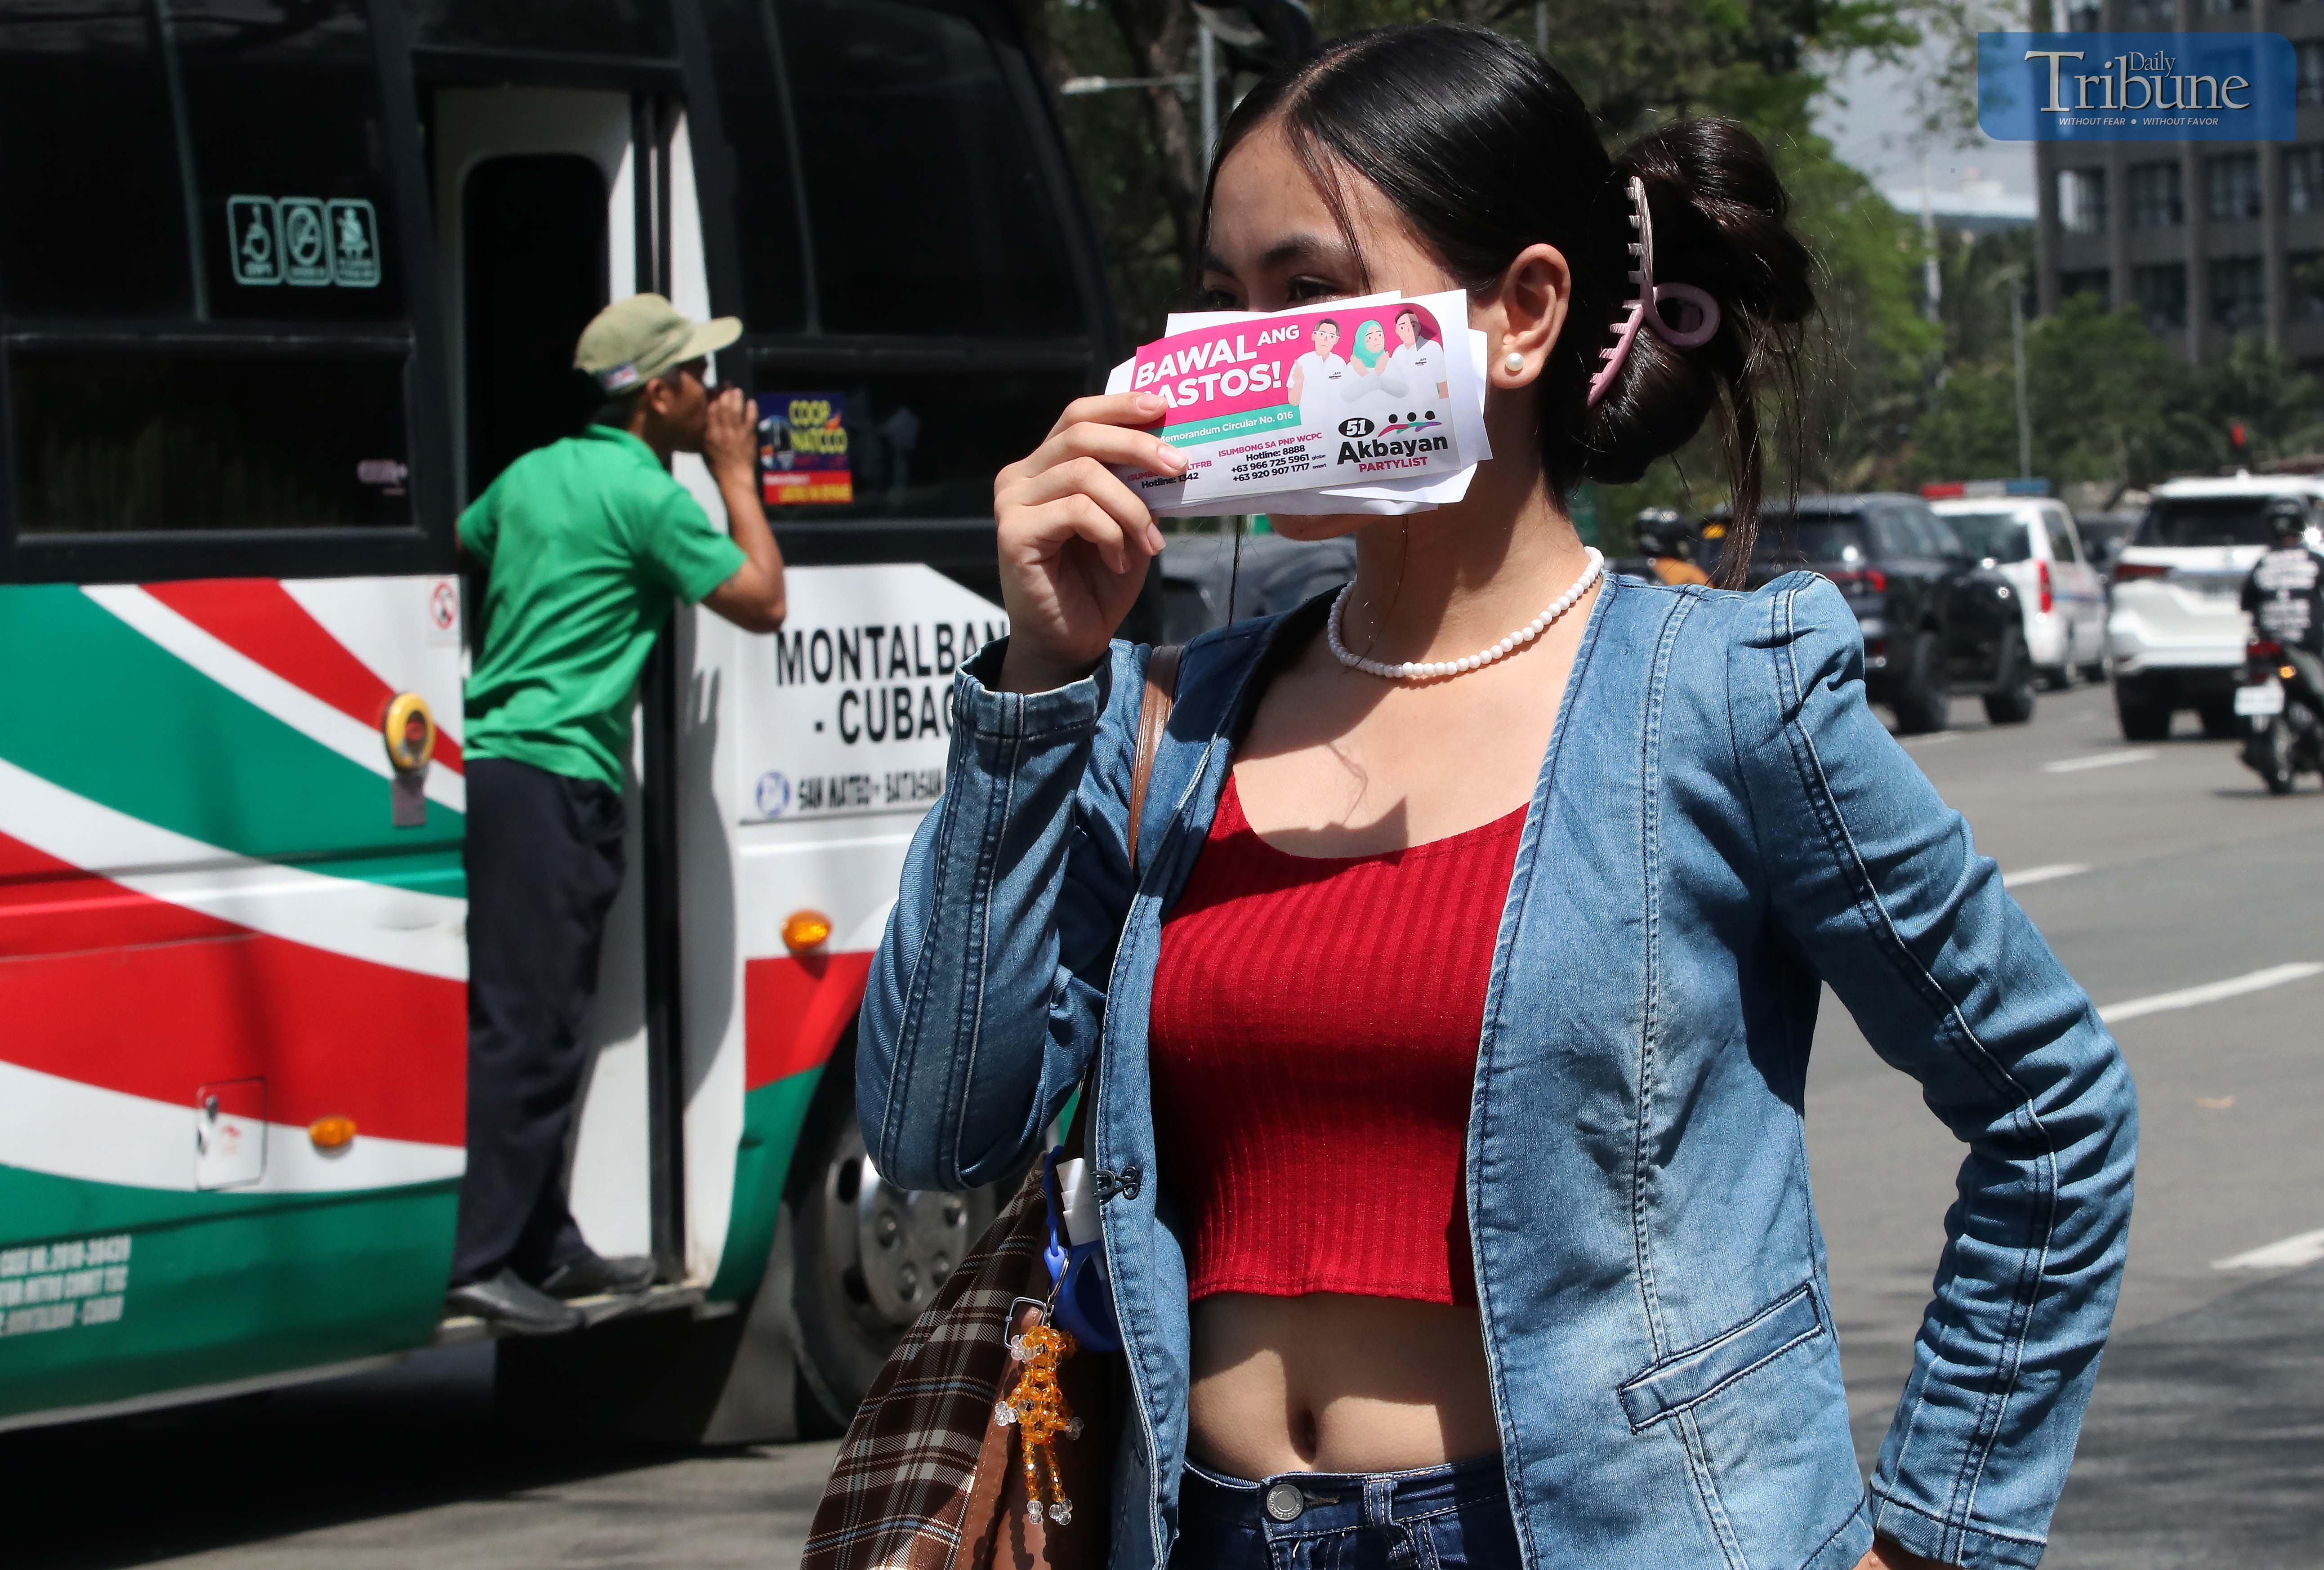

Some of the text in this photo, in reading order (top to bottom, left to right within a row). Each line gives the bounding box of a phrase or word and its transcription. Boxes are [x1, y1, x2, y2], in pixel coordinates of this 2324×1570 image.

[1134, 325, 1300, 390] BAWAL ANG
[1143, 361, 1281, 409] ASTOS!
[1222, 419, 1258, 432] Circular
[1259, 415, 1275, 425] No.
[1277, 411, 1294, 421] 016
[1346, 419, 1366, 436] 51
[1218, 433, 1322, 457] ISUMBONG SA PNP WCPC
[1246, 445, 1305, 462] Hotline: 8888
[1337, 435, 1448, 465] Akbayan
[1231, 464, 1248, 473] +63
[1250, 461, 1267, 470] 966
[1270, 458, 1286, 468] 725
[1288, 454, 1309, 464] 5961
[1233, 473, 1250, 482] +63
[1252, 470, 1270, 479] 920
[1272, 466, 1289, 476] 907
[1291, 463, 1309, 472] 1717
[1359, 456, 1427, 472] PARTYLIST
[1142, 477, 1176, 489] Hotline:
